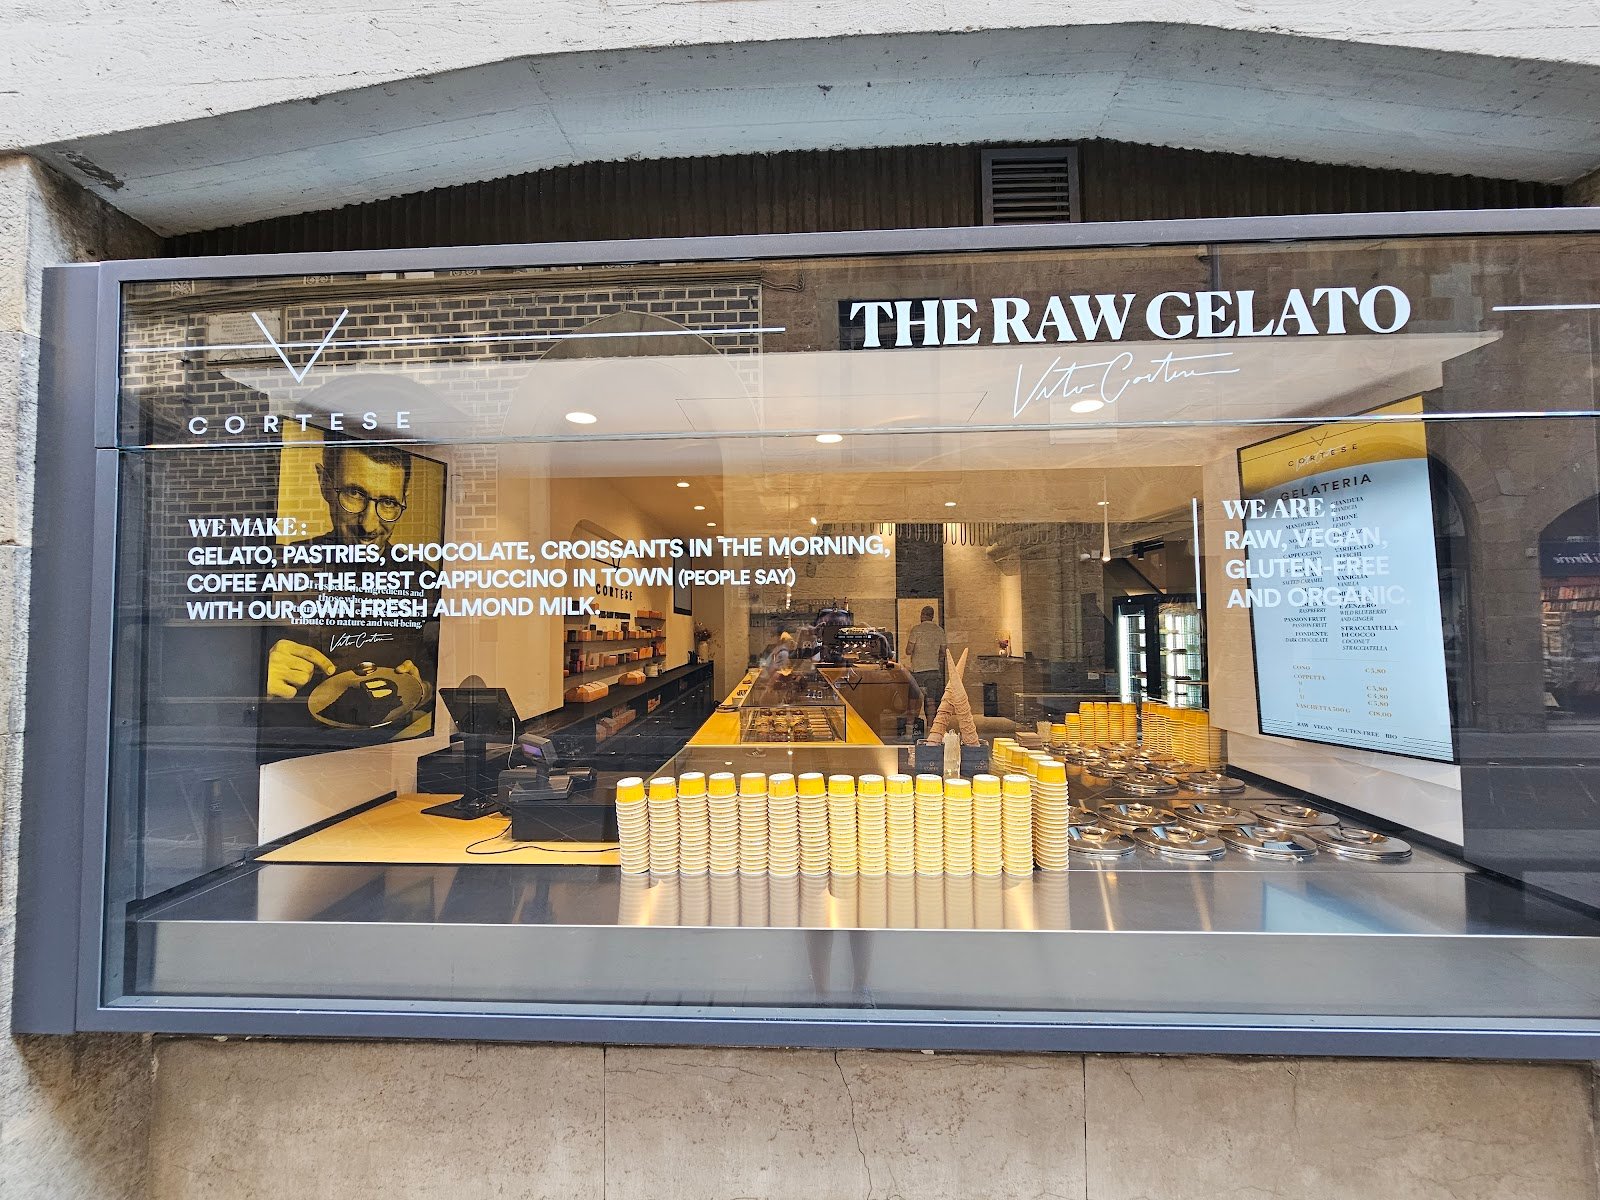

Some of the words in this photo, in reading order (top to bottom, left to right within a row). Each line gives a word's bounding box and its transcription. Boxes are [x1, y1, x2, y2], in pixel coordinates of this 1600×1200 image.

[849, 298, 982, 348] THE
[991, 293, 1137, 343] RAW
[1145, 284, 1412, 339] GELATO
[188, 411, 411, 435] CORTESE
[1288, 443, 1358, 467] CORTESE
[1280, 473, 1372, 500] GELATERIA
[1222, 499, 1268, 520] WE
[1271, 497, 1327, 519] ARE
[1332, 513, 1358, 522] LIMONE
[188, 518, 227, 537] WE
[230, 517, 298, 537] MAKE
[1224, 529, 1288, 552] RAW,
[1293, 526, 1389, 549] VEGAN,
[187, 545, 278, 569] GELATO,
[282, 543, 387, 567] PASTRIES,
[390, 541, 536, 564] CHOCOLATE,
[540, 537, 685, 560] CROISSANTS
[688, 537, 713, 557] IN
[717, 536, 769, 557] THE
[771, 534, 891, 559] MORNING,
[1282, 550, 1322, 559] CAPPUCCINO
[1225, 555, 1391, 579] GLUTEN-FREE
[186, 573, 257, 593] COFEE
[261, 572, 308, 592] AND
[313, 571, 357, 591] THE
[361, 570, 415, 590] BEST
[418, 567, 567, 590] CAPPUCCINO
[573, 567, 596, 587] IN
[601, 566, 674, 587] TOWN
[678, 568, 751, 590] (PEOPLE
[754, 566, 797, 588] SAY)
[410, 588, 424, 597] and
[595, 583, 633, 601] CORTESE
[1226, 588, 1282, 609] AND
[1287, 584, 1411, 608] ORGANIC.
[186, 601, 244, 621] WITH
[247, 601, 294, 620] OUR
[299, 599, 356, 619] OWN
[360, 598, 428, 618] FRESH
[433, 597, 535, 618] ALMOND
[540, 596, 601, 616] MILK.
[290, 616, 324, 626] tribute
[326, 618, 336, 626] to
[336, 618, 366, 627] nature
[366, 618, 382, 627] and
